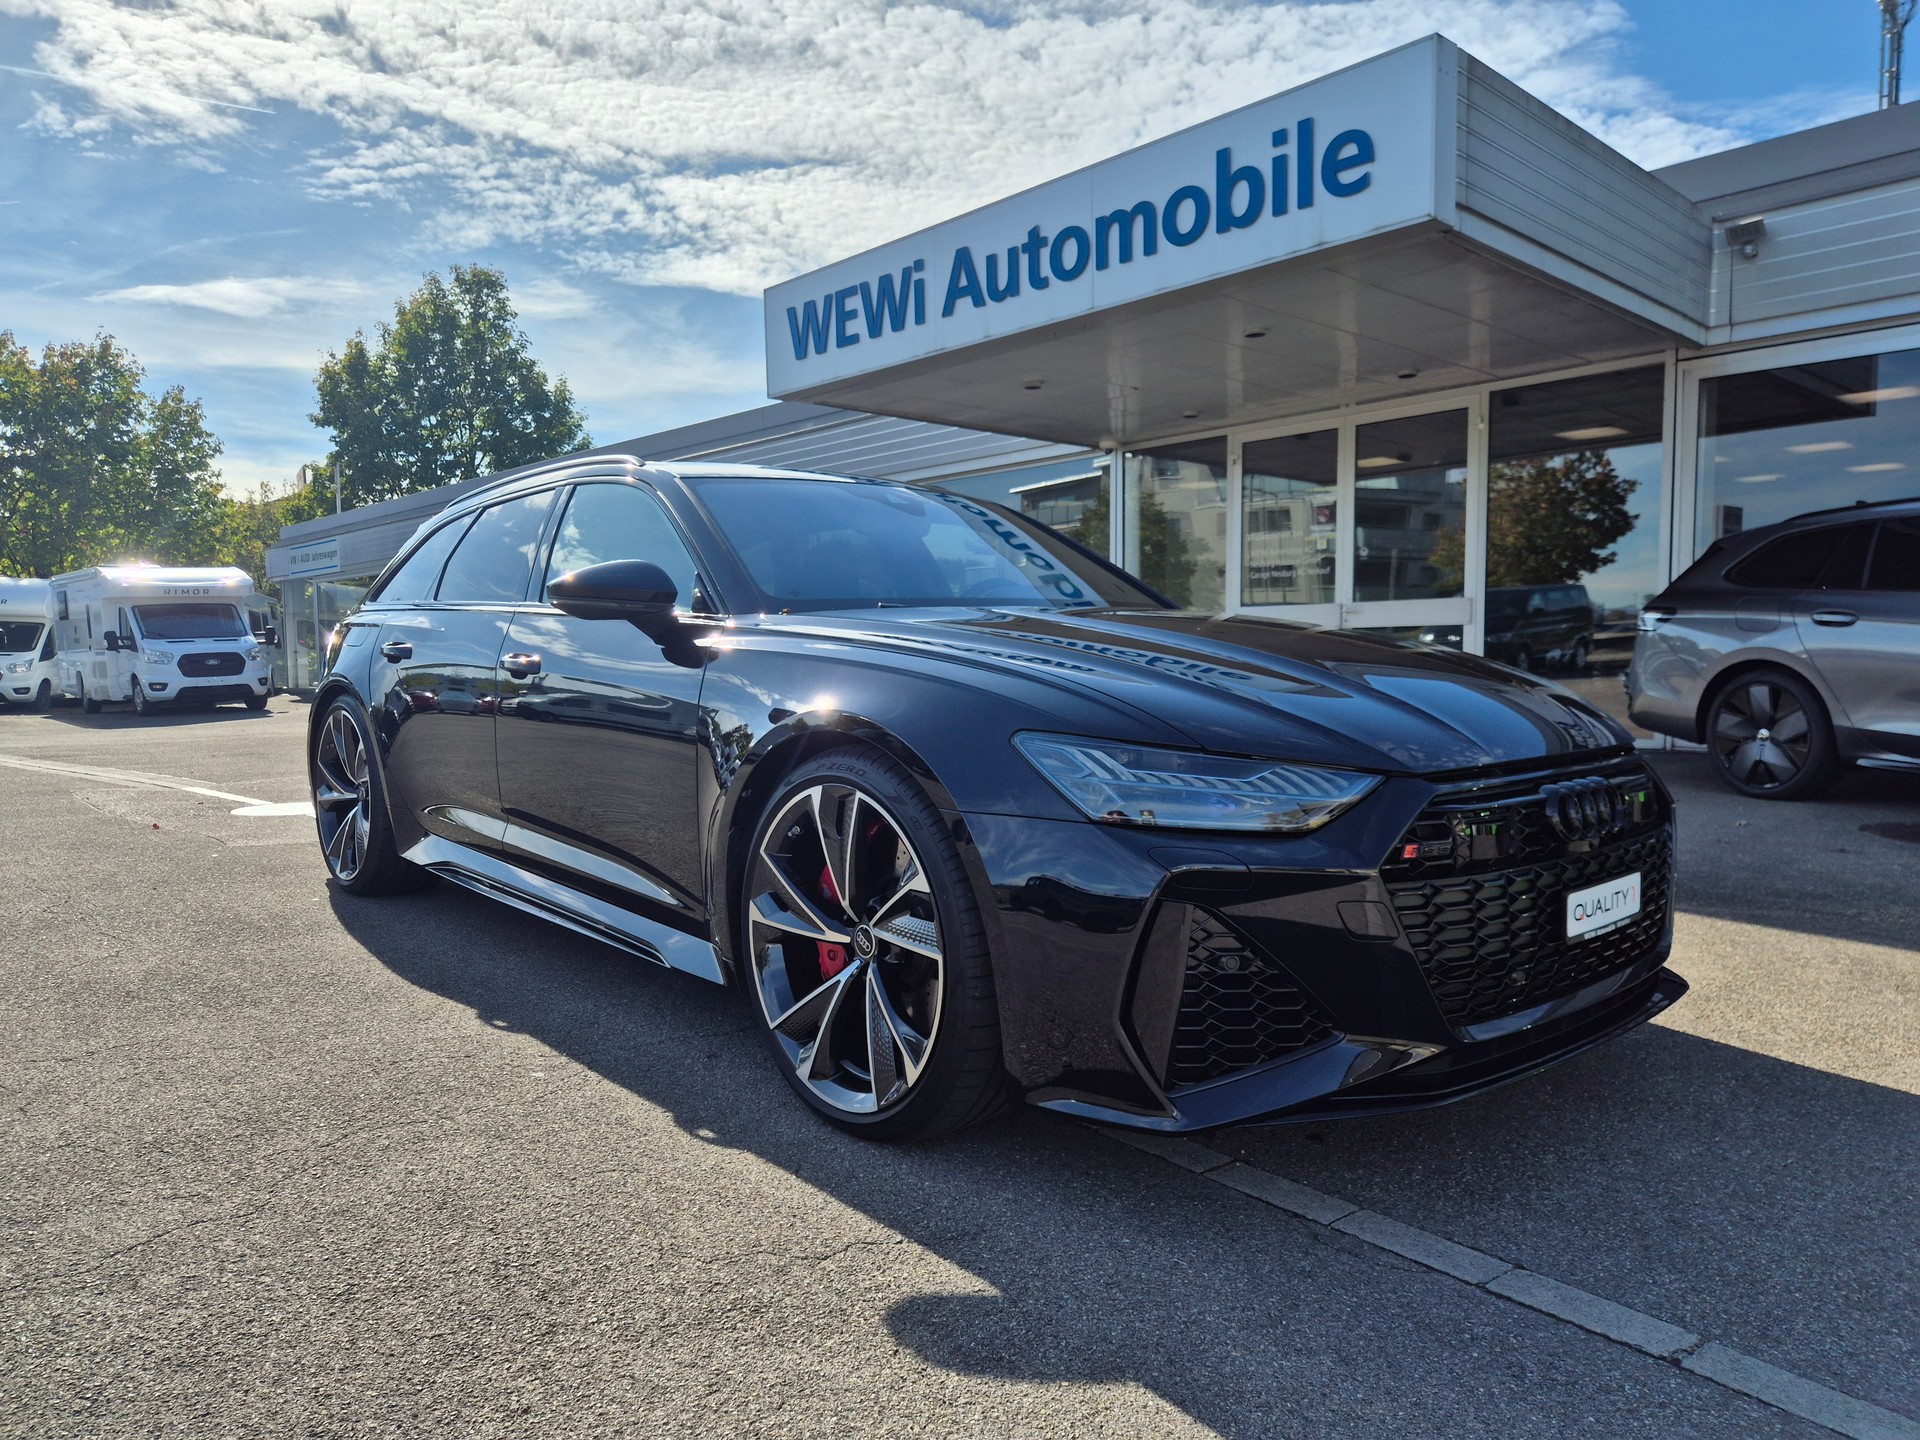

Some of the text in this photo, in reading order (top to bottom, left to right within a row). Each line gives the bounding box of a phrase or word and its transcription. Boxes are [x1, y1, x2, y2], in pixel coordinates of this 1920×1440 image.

[786, 116, 1375, 361] WEWi Automobile
[164, 588, 210, 596] RIMOR
[826, 762, 868, 777] ZERO
